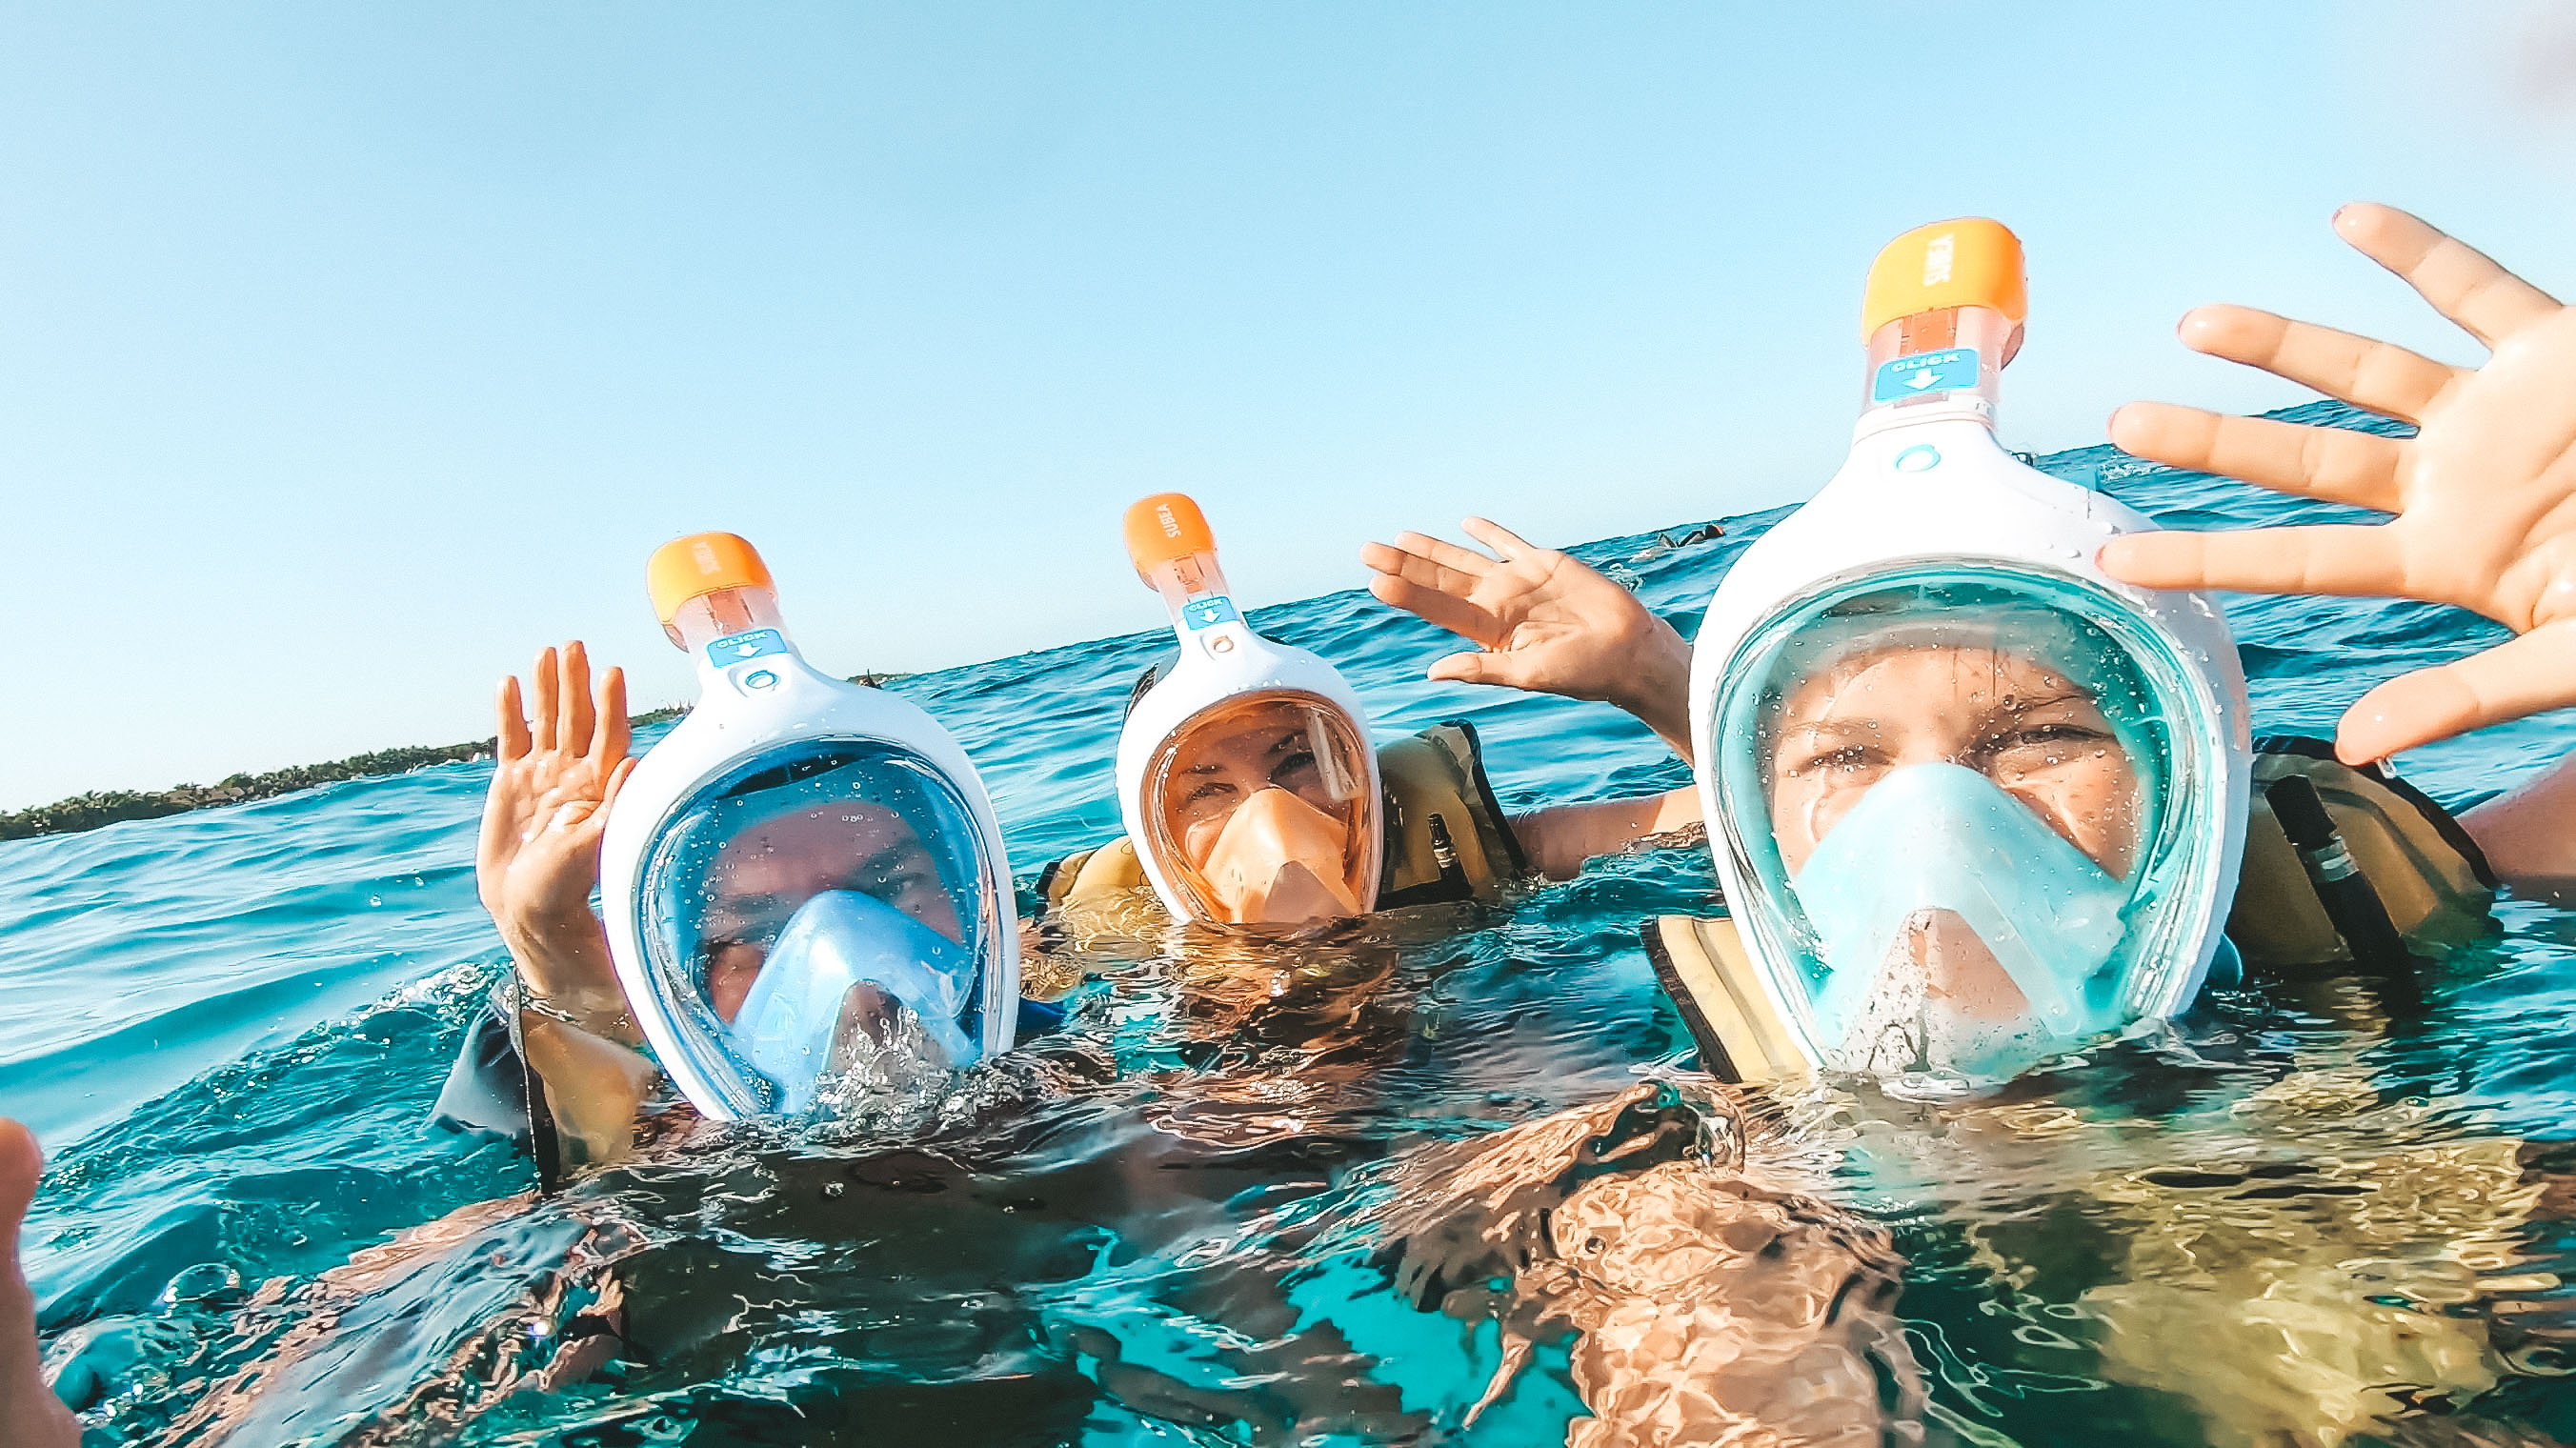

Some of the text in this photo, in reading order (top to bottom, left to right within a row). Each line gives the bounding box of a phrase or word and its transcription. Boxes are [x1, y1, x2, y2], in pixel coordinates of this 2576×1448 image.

[1890, 352, 1960, 372] CLICK
[1156, 503, 1181, 538] SUBEA
[1188, 598, 1223, 611] CLICK
[716, 632, 768, 648] CLICK
